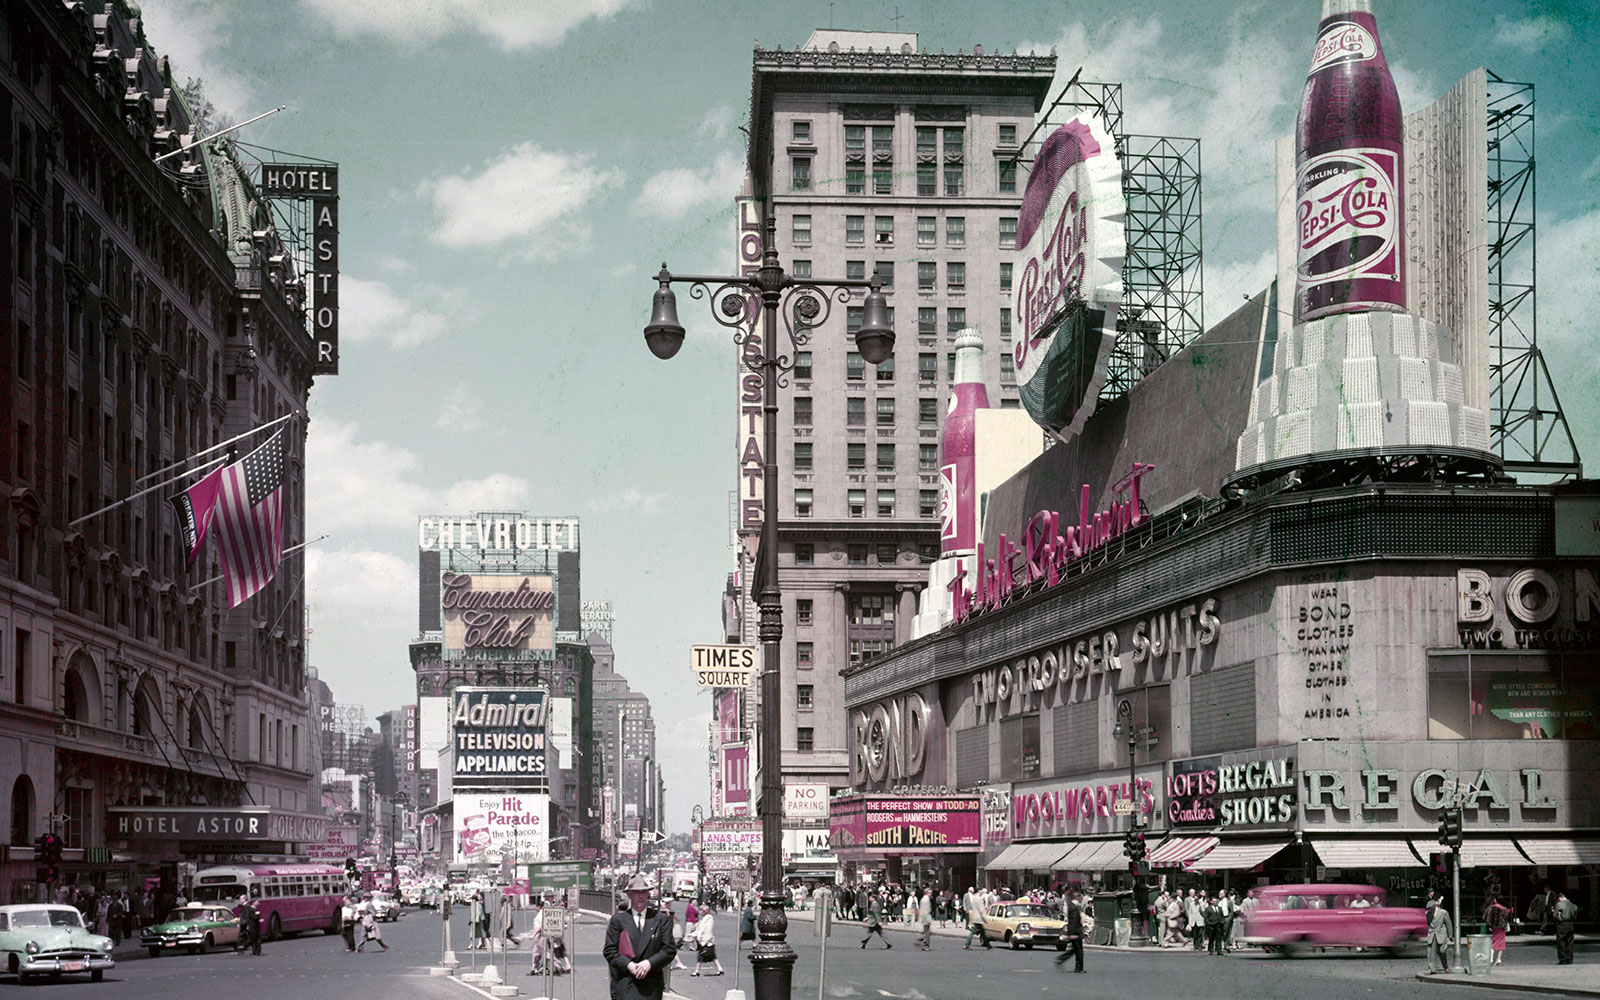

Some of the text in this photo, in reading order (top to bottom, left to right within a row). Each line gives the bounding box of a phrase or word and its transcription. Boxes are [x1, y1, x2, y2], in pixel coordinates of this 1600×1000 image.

[267, 169, 333, 192] HOTEL
[317, 204, 333, 363] ASTOR
[741, 374, 763, 528] STATE
[418, 518, 579, 550] CHEVROLET
[442, 571, 556, 610] Canadian
[1311, 587, 1339, 601] WEAR
[581, 600, 608, 609] PARK
[1299, 602, 1351, 623] BOND
[462, 609, 535, 648] Club
[1297, 624, 1355, 641] CLOTHES
[1460, 629, 1505, 643] TWO
[694, 648, 753, 668] TIMES
[971, 598, 1221, 707] TWO TROUSER SUITS
[1302, 644, 1350, 657] THAN ANY
[1308, 661, 1343, 673] OTHER
[698, 672, 748, 686] SQUARE
[1305, 676, 1348, 689] CLOTHES
[1321, 693, 1332, 703] IN
[321, 706, 366, 721] PITOL
[452, 693, 549, 727] Admiral
[1303, 708, 1350, 720] AMERICA
[407, 708, 415, 772] HOWARD
[457, 733, 545, 750] TELEVISION
[853, 691, 932, 786] BOND
[456, 755, 545, 772] APPLIANCES
[1166, 770, 1218, 798] LOFT'S
[1218, 758, 1294, 794] REGAL
[795, 788, 816, 799] NO
[893, 784, 957, 796] CRITERION
[1304, 768, 1559, 810] REGAL
[479, 797, 522, 812] Enjoy Hit
[788, 801, 824, 810] PARKING
[867, 802, 880, 810] THE
[881, 802, 911, 810] PERFECT
[913, 802, 934, 810] SHOW
[936, 802, 943, 810] IN
[1014, 777, 1155, 823] WOOLWORTH'S
[487, 811, 540, 825] Parade
[867, 813, 894, 822] RODGERS
[1169, 800, 1216, 824] Candies
[1220, 794, 1292, 827] SHOES
[119, 817, 259, 834] HOTEL ASTOR
[271, 815, 326, 840] HOTEL ASTOR
[492, 830, 505, 839] the
[506, 829, 537, 837] toacco
[702, 834, 732, 843] LANAS
[867, 825, 902, 845] SOUTH
[909, 825, 947, 845] PACIFIC
[1389, 874, 1467, 891] Platter Picks
